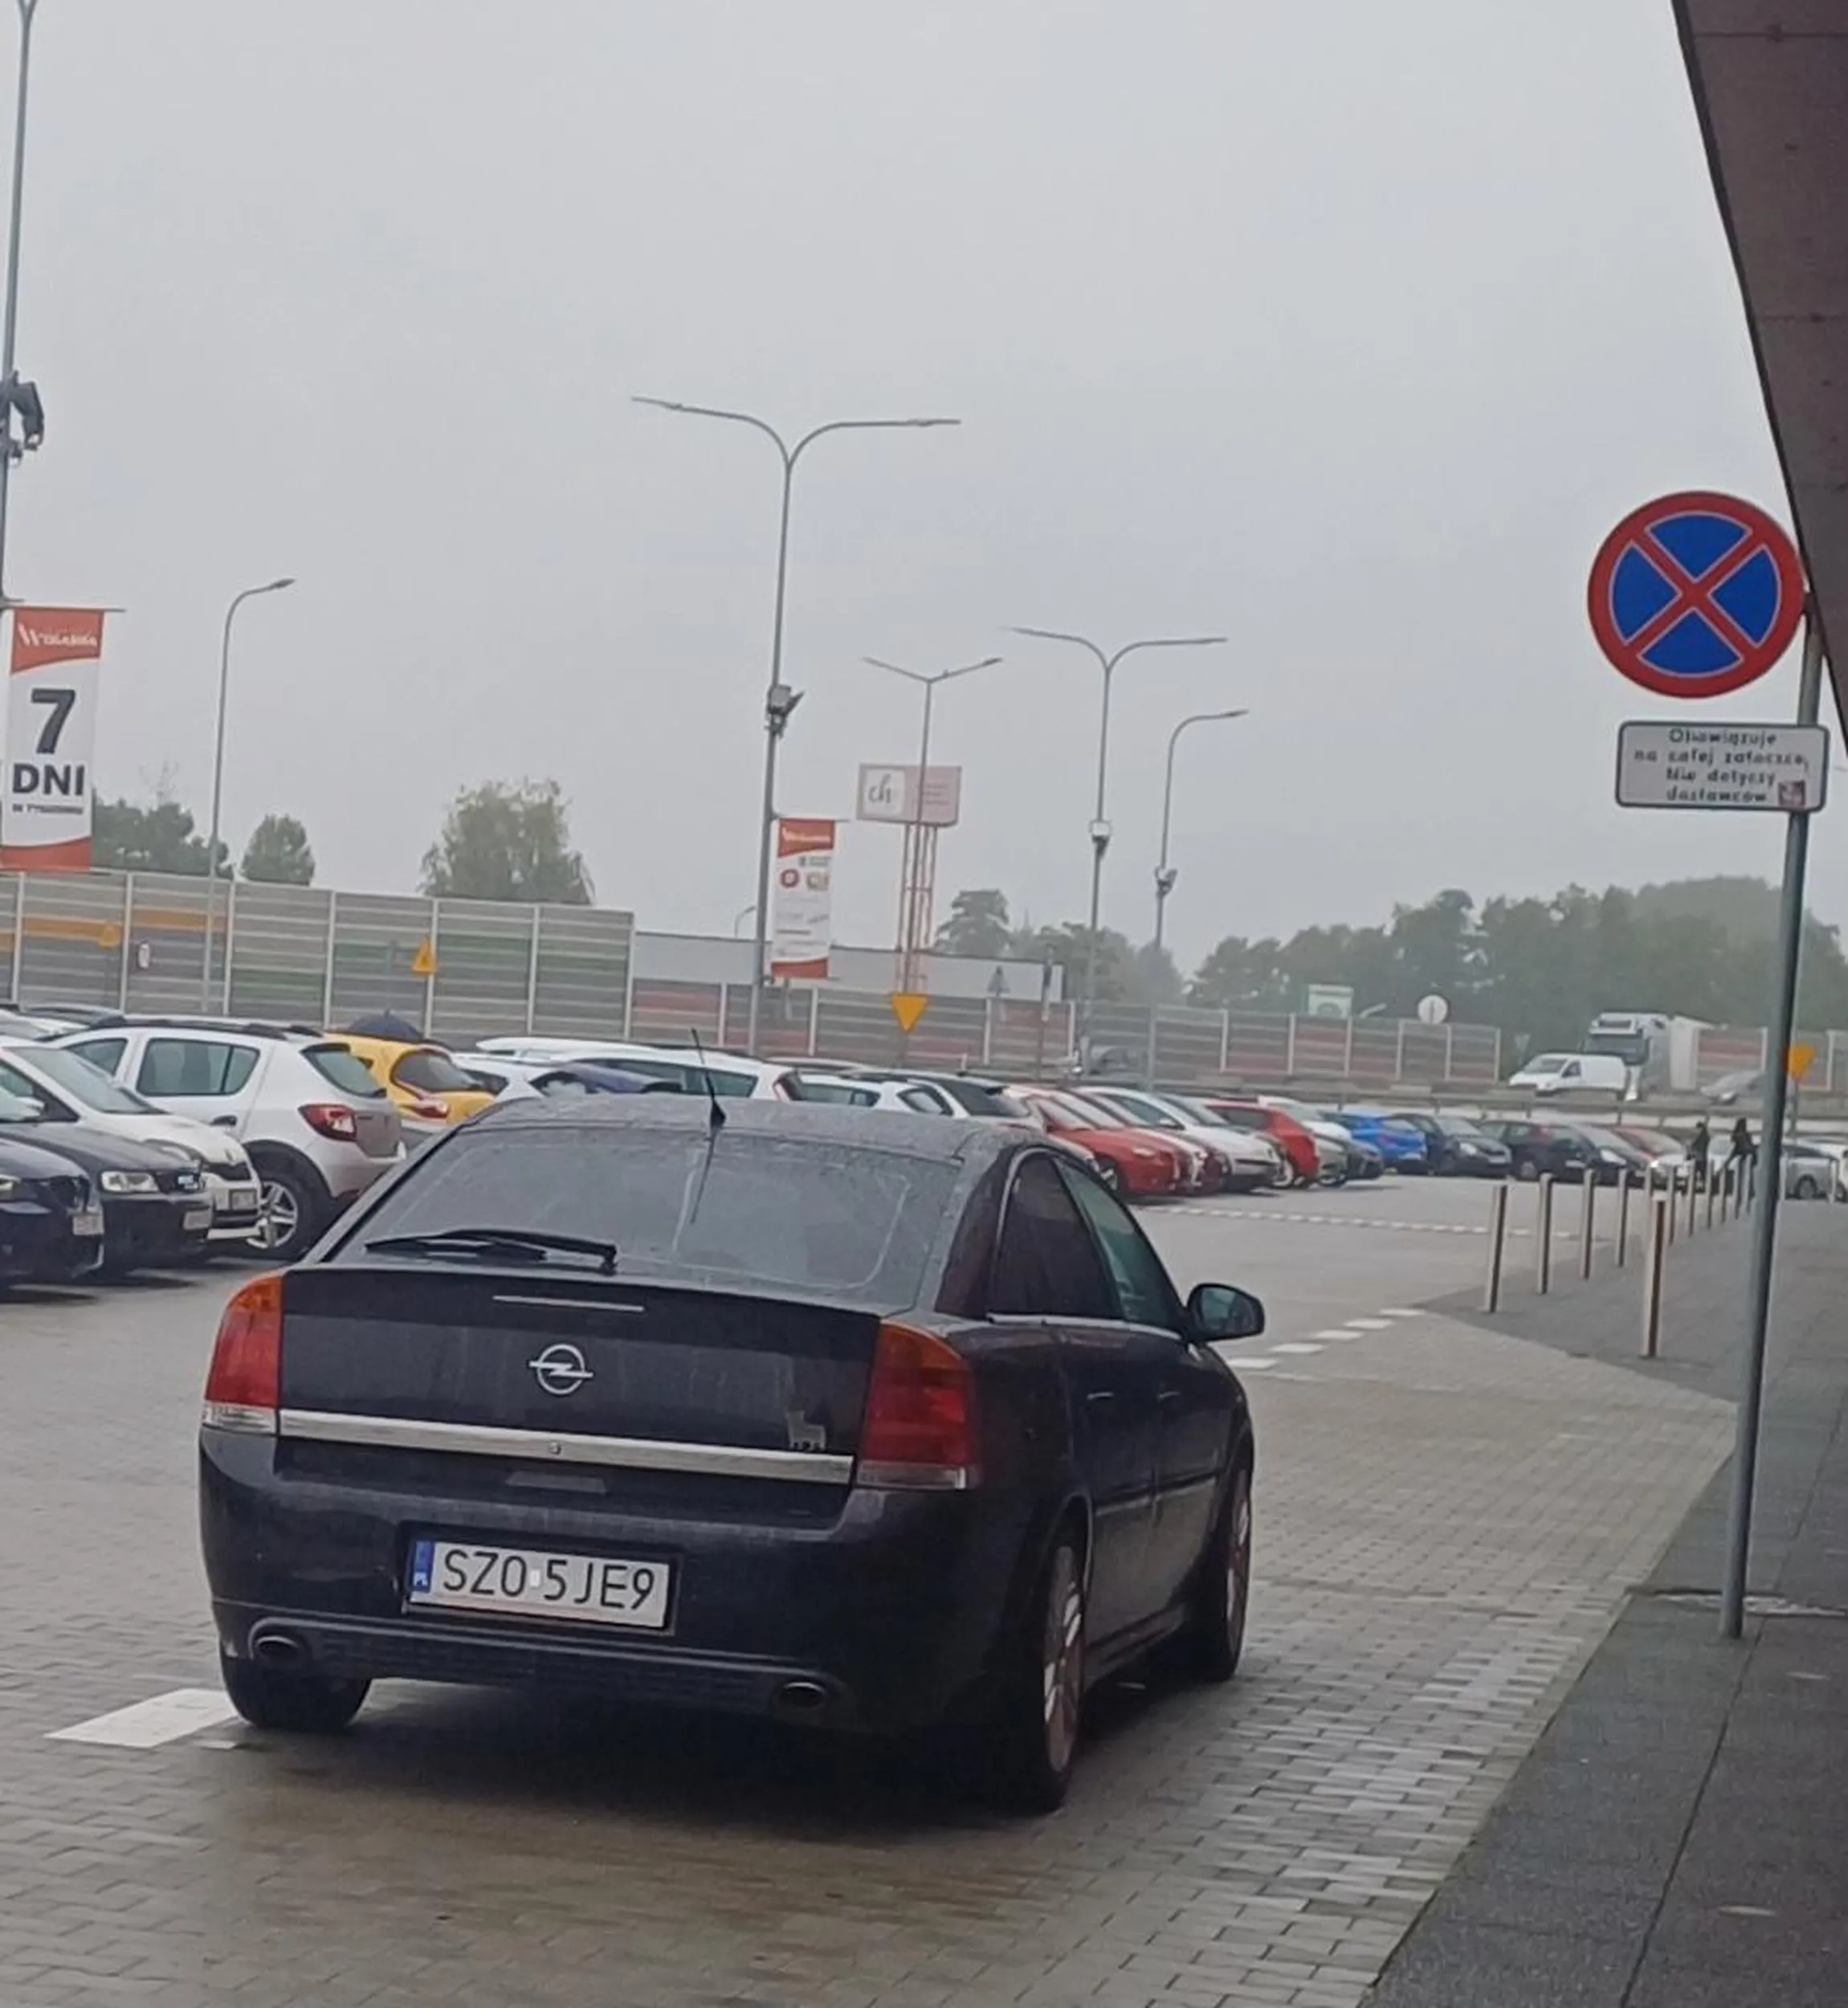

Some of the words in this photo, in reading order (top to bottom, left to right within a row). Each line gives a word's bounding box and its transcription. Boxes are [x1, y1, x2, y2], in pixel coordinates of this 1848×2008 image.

[31, 688, 75, 754] 7
[13, 762, 84, 795] DNI
[543, 1560, 655, 1610] 5JE9
